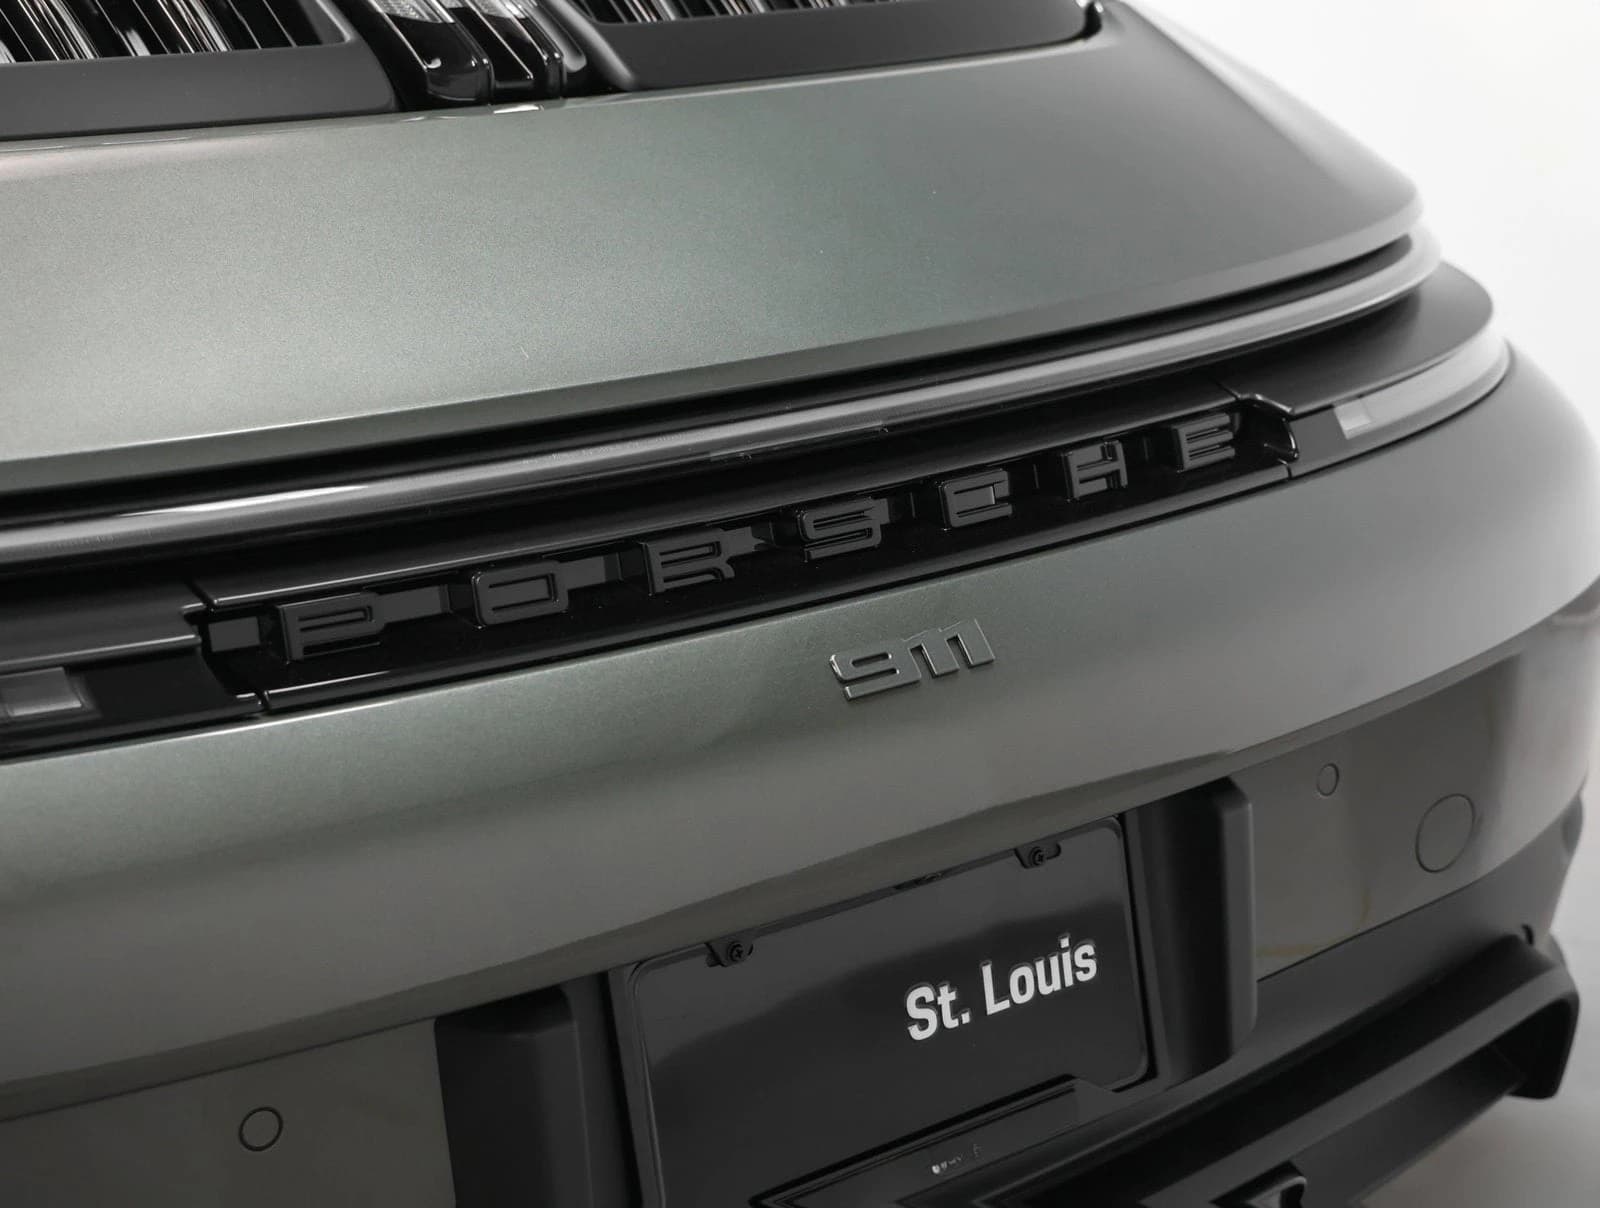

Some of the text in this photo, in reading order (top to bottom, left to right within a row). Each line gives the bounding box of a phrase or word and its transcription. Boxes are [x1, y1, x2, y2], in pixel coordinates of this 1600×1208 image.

[277, 411, 1237, 663] PORSCHE
[830, 617, 996, 701] 911
[905, 935, 1098, 1041] St. Louis
